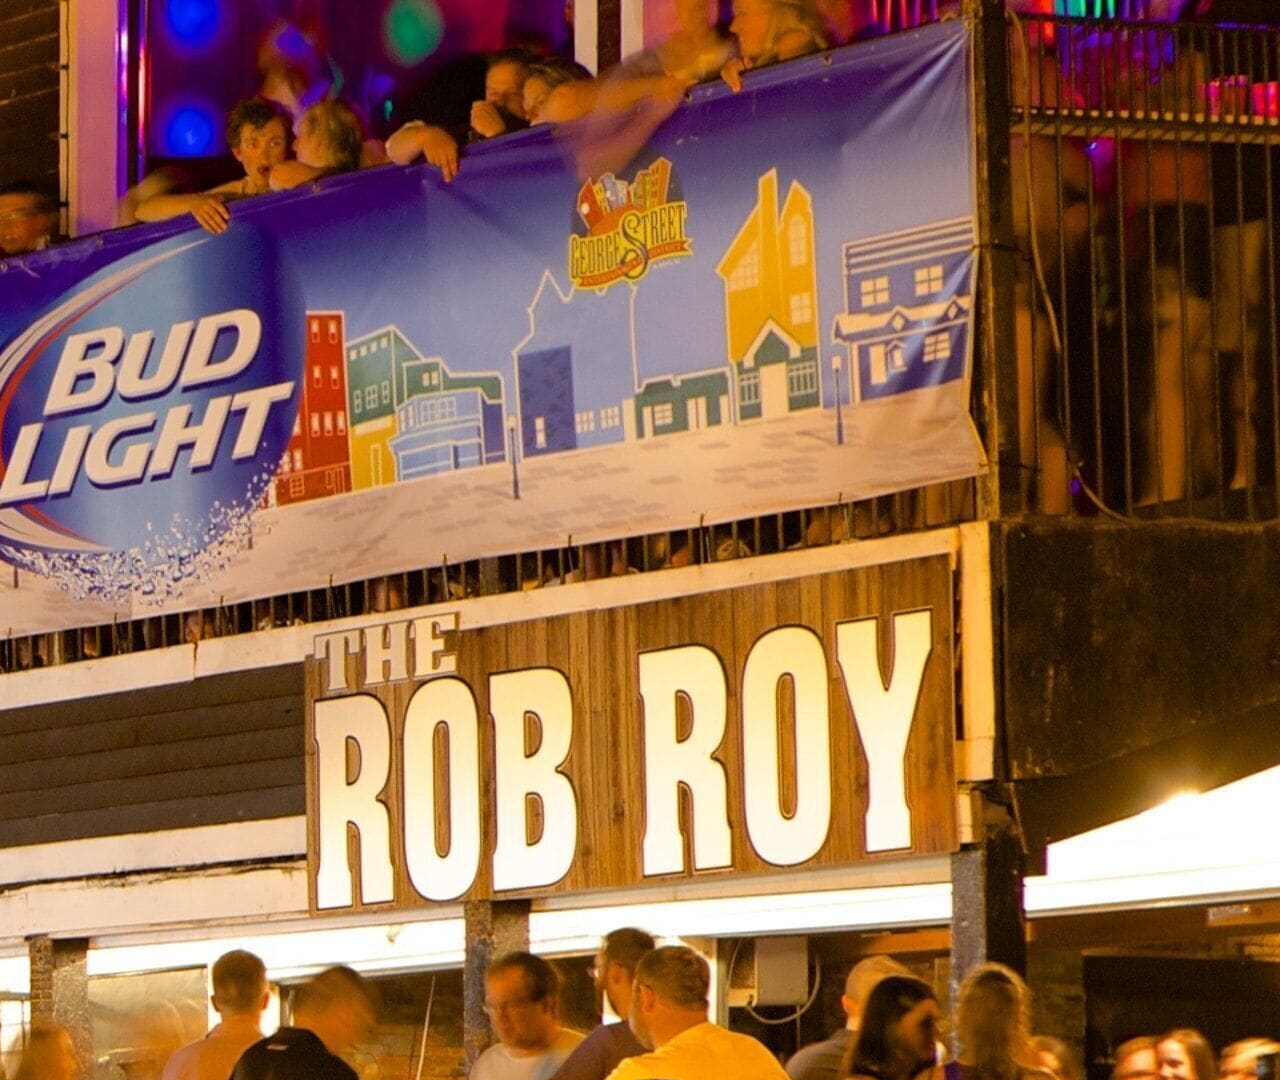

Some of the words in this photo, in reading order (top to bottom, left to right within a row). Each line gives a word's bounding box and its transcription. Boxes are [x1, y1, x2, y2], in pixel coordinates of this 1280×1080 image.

[571, 231, 622, 279] GEORGE
[621, 203, 686, 279] STREET
[43, 308, 262, 417] BUD
[314, 612, 459, 691] THE
[313, 666, 578, 911] ROB
[637, 608, 933, 878] ROY
